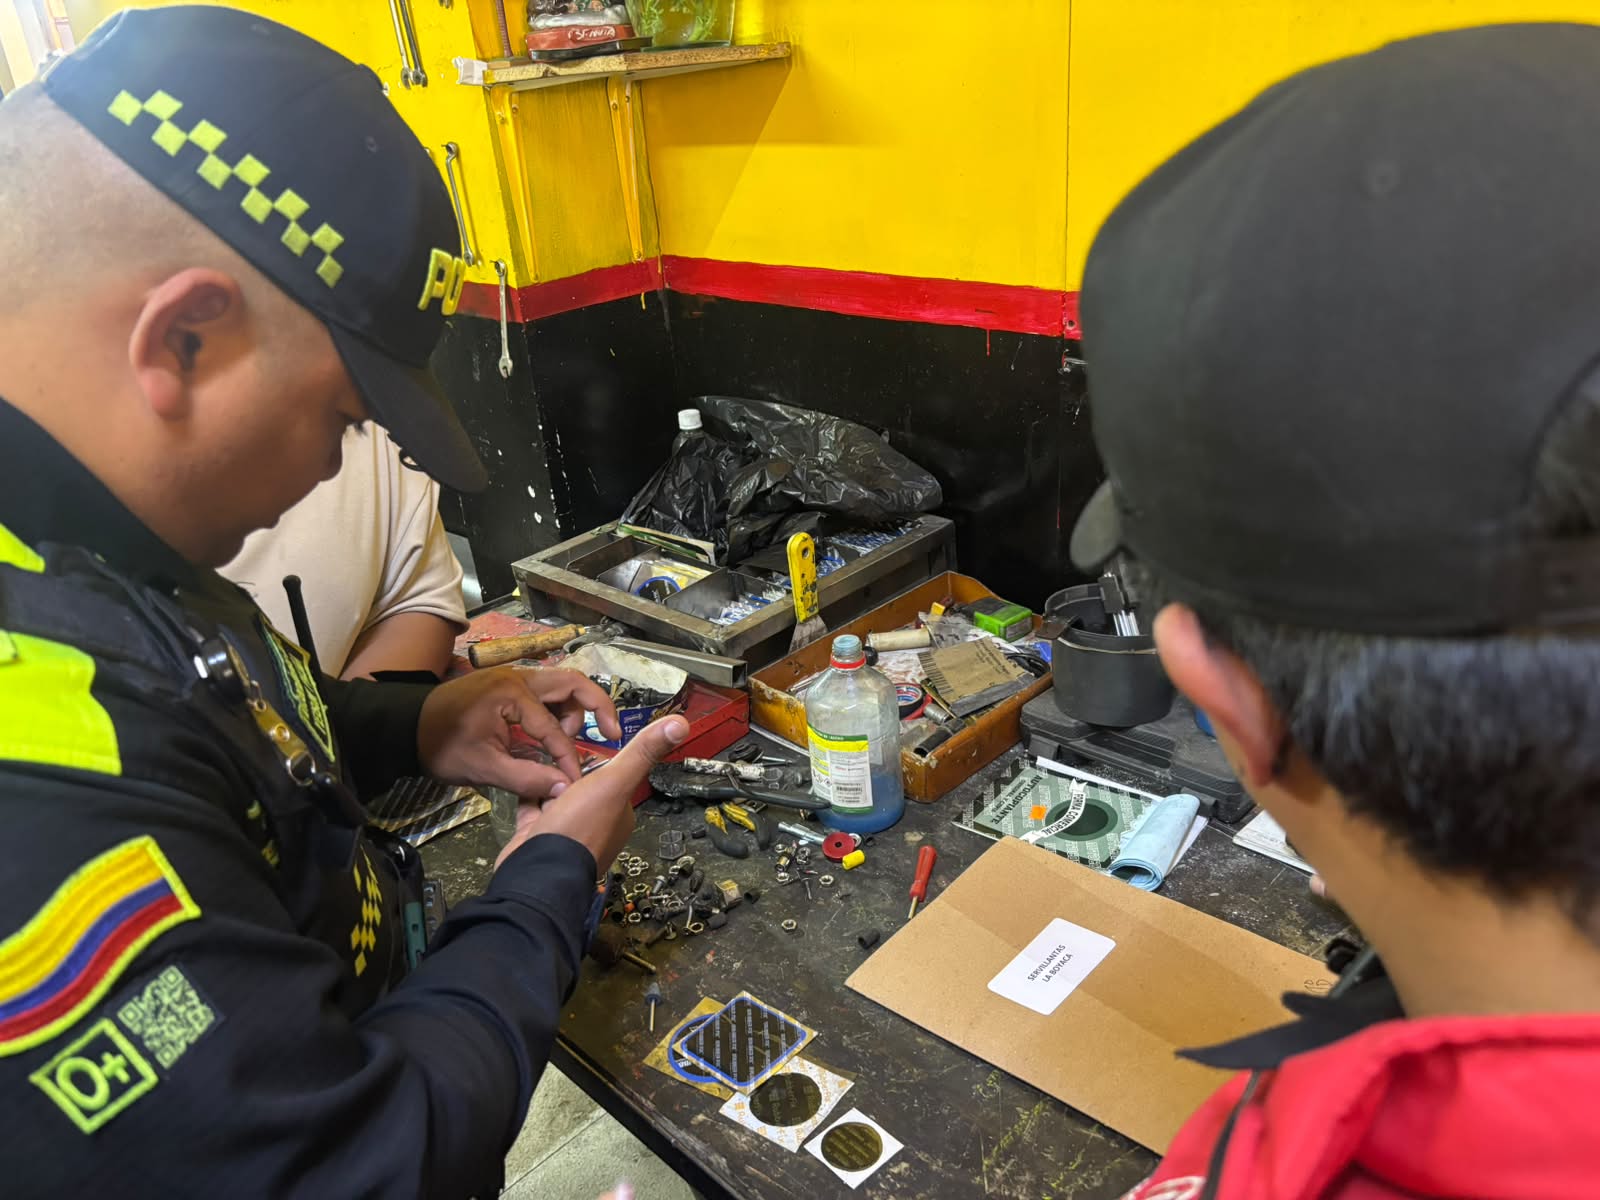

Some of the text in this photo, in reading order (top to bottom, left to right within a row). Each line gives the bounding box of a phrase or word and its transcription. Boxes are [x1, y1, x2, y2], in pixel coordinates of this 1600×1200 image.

[990, 774, 1043, 825] AUTOCOPIANTE
[1041, 809, 1079, 836] COMERCIAL
[1027, 944, 1066, 982] SERVILLANTAS
[1042, 953, 1073, 983] LA BOYACA
